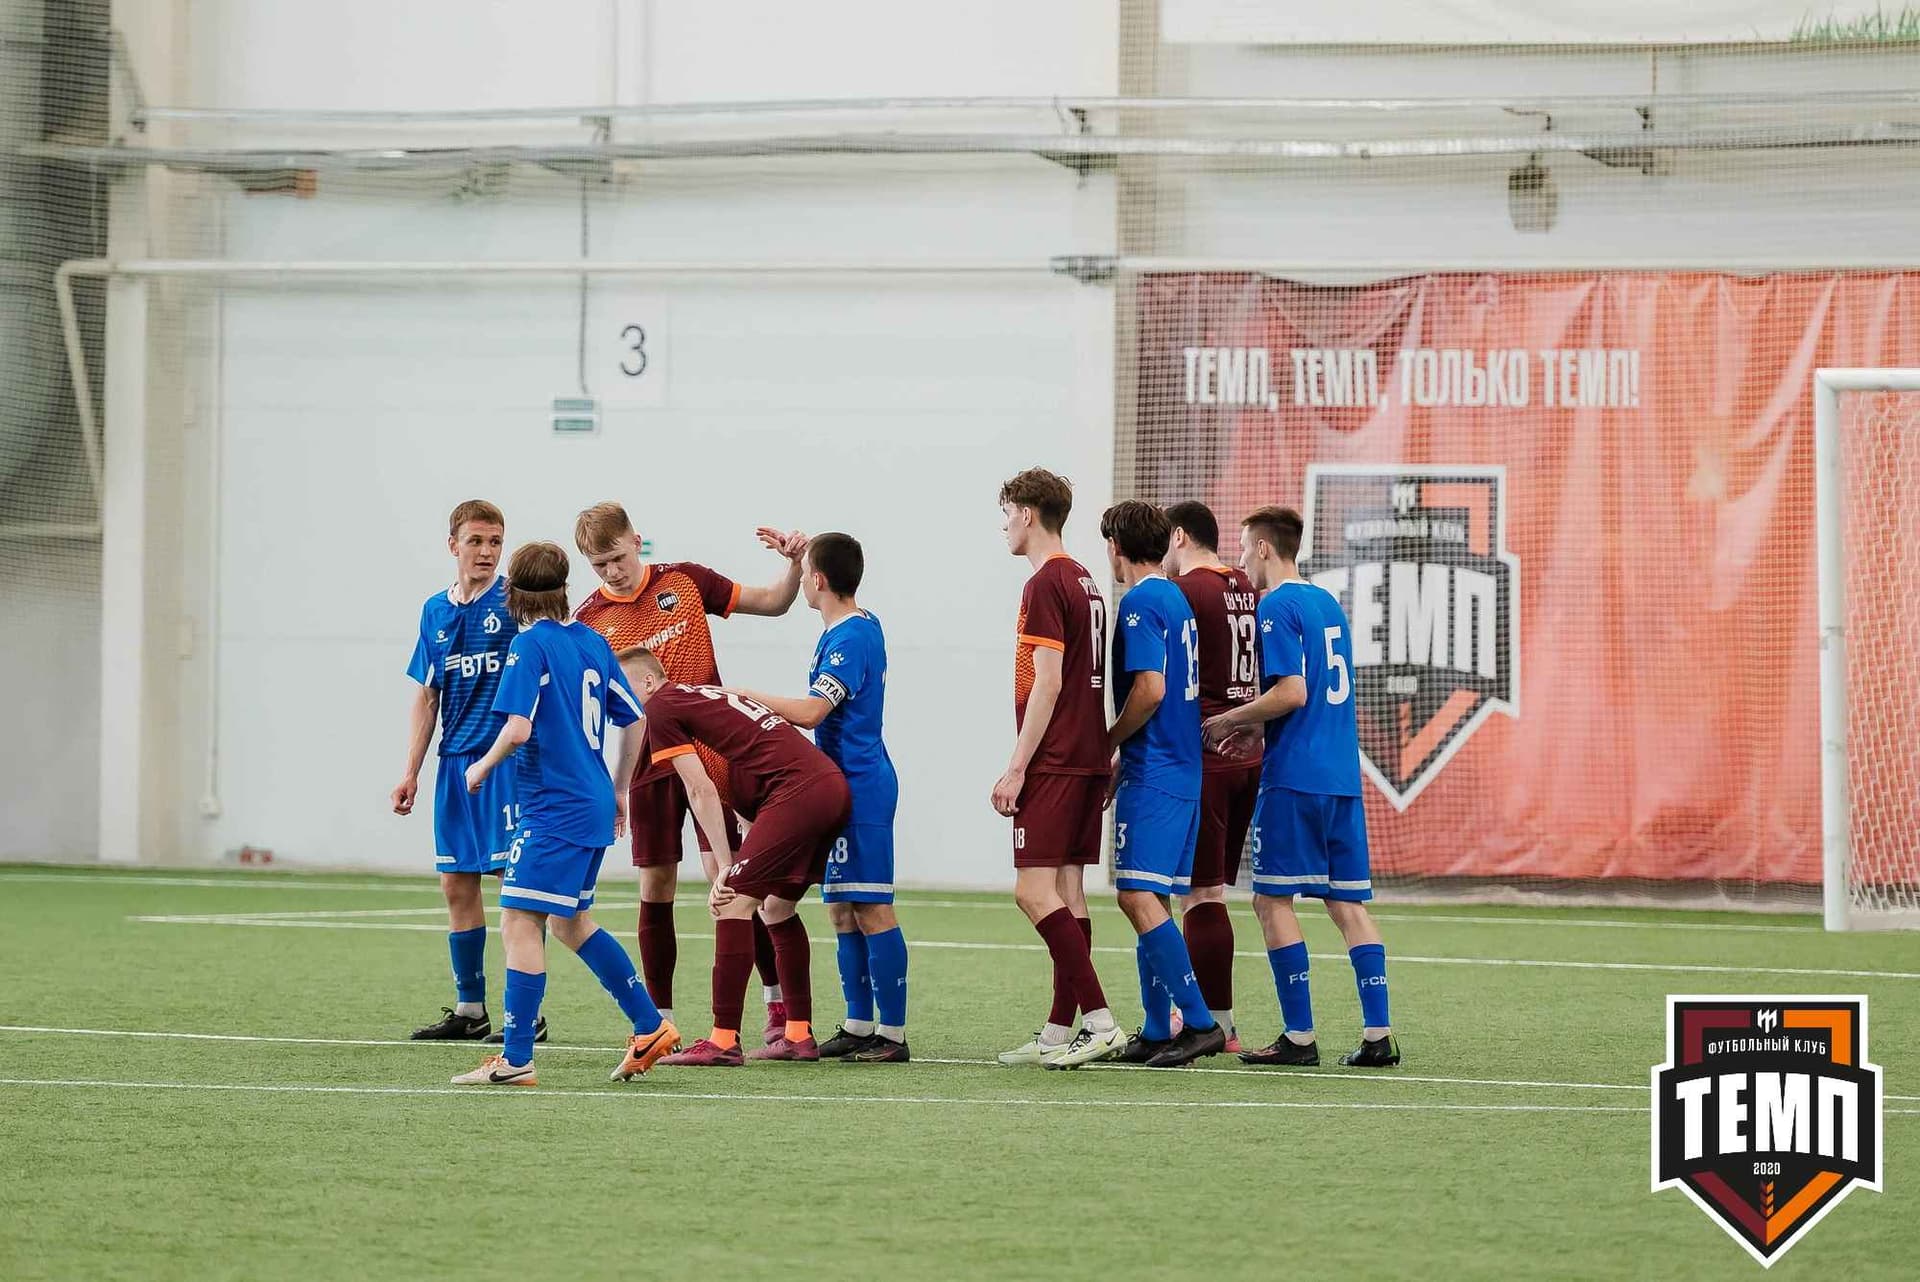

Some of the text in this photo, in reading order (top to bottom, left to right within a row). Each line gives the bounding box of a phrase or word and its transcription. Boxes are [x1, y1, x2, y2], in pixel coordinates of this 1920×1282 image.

[621, 324, 647, 377] 3
[1184, 347, 1640, 414] ТЕМП, ТЕМП, ТОЛЬКО ТЕМП!
[461, 651, 500, 678] ВТБ
[1227, 613, 1257, 683] 13
[1323, 625, 1351, 705] 5
[582, 668, 601, 750] 6
[509, 838, 525, 865] 6
[1014, 827, 1025, 849] 18
[1253, 827, 1262, 854] 5
